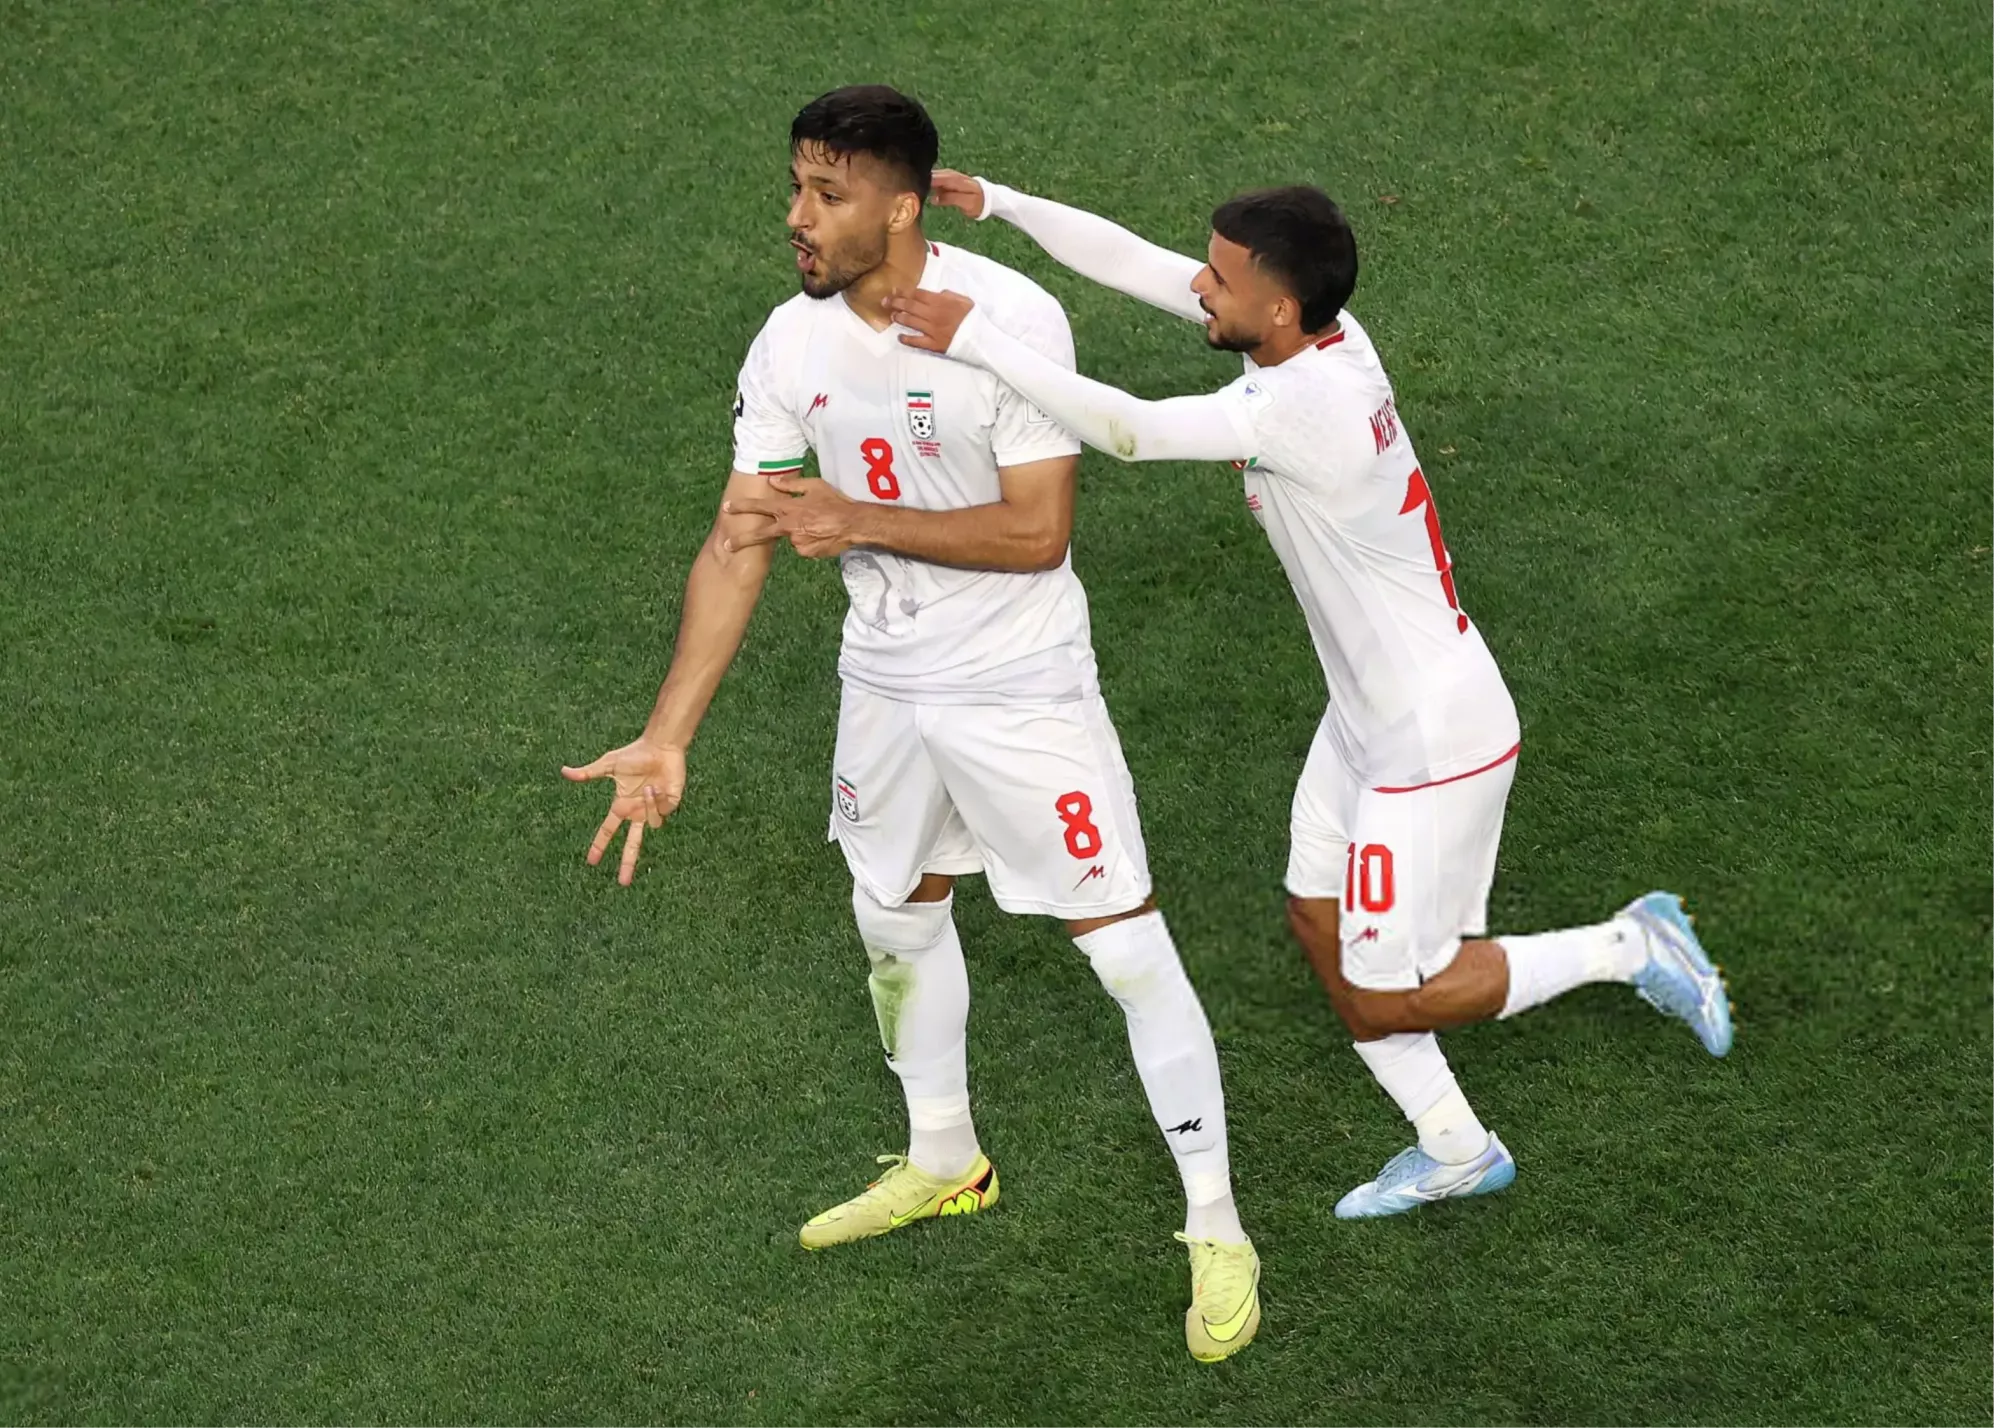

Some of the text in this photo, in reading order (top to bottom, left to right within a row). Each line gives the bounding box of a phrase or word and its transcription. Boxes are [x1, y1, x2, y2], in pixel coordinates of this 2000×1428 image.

[1368, 394, 1398, 456] MEH
[859, 436, 903, 502] 8
[1054, 790, 1104, 861] 8
[1345, 841, 1395, 913] 10
